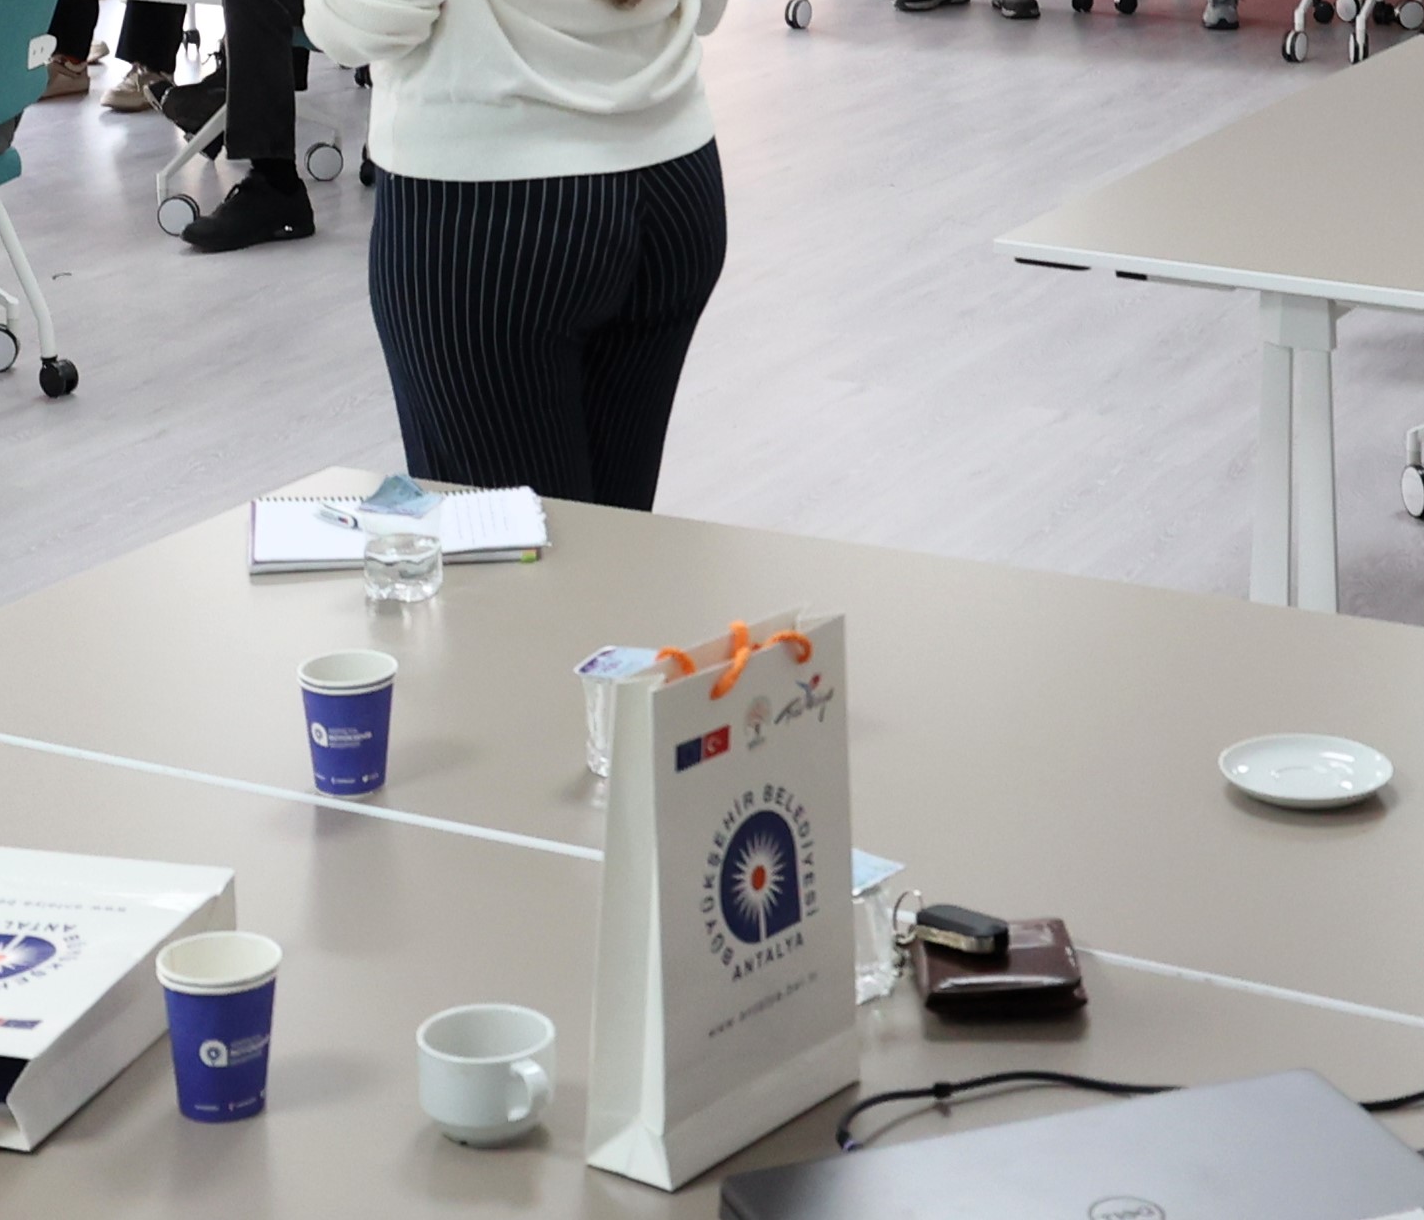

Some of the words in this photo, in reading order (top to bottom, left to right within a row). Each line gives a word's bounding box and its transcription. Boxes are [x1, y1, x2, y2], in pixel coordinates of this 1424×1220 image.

[700, 790, 755, 967] BÜYÜKŞEHİR
[762, 783, 819, 918] BELEDİYESİ
[732, 931, 805, 981] ANTALYA
